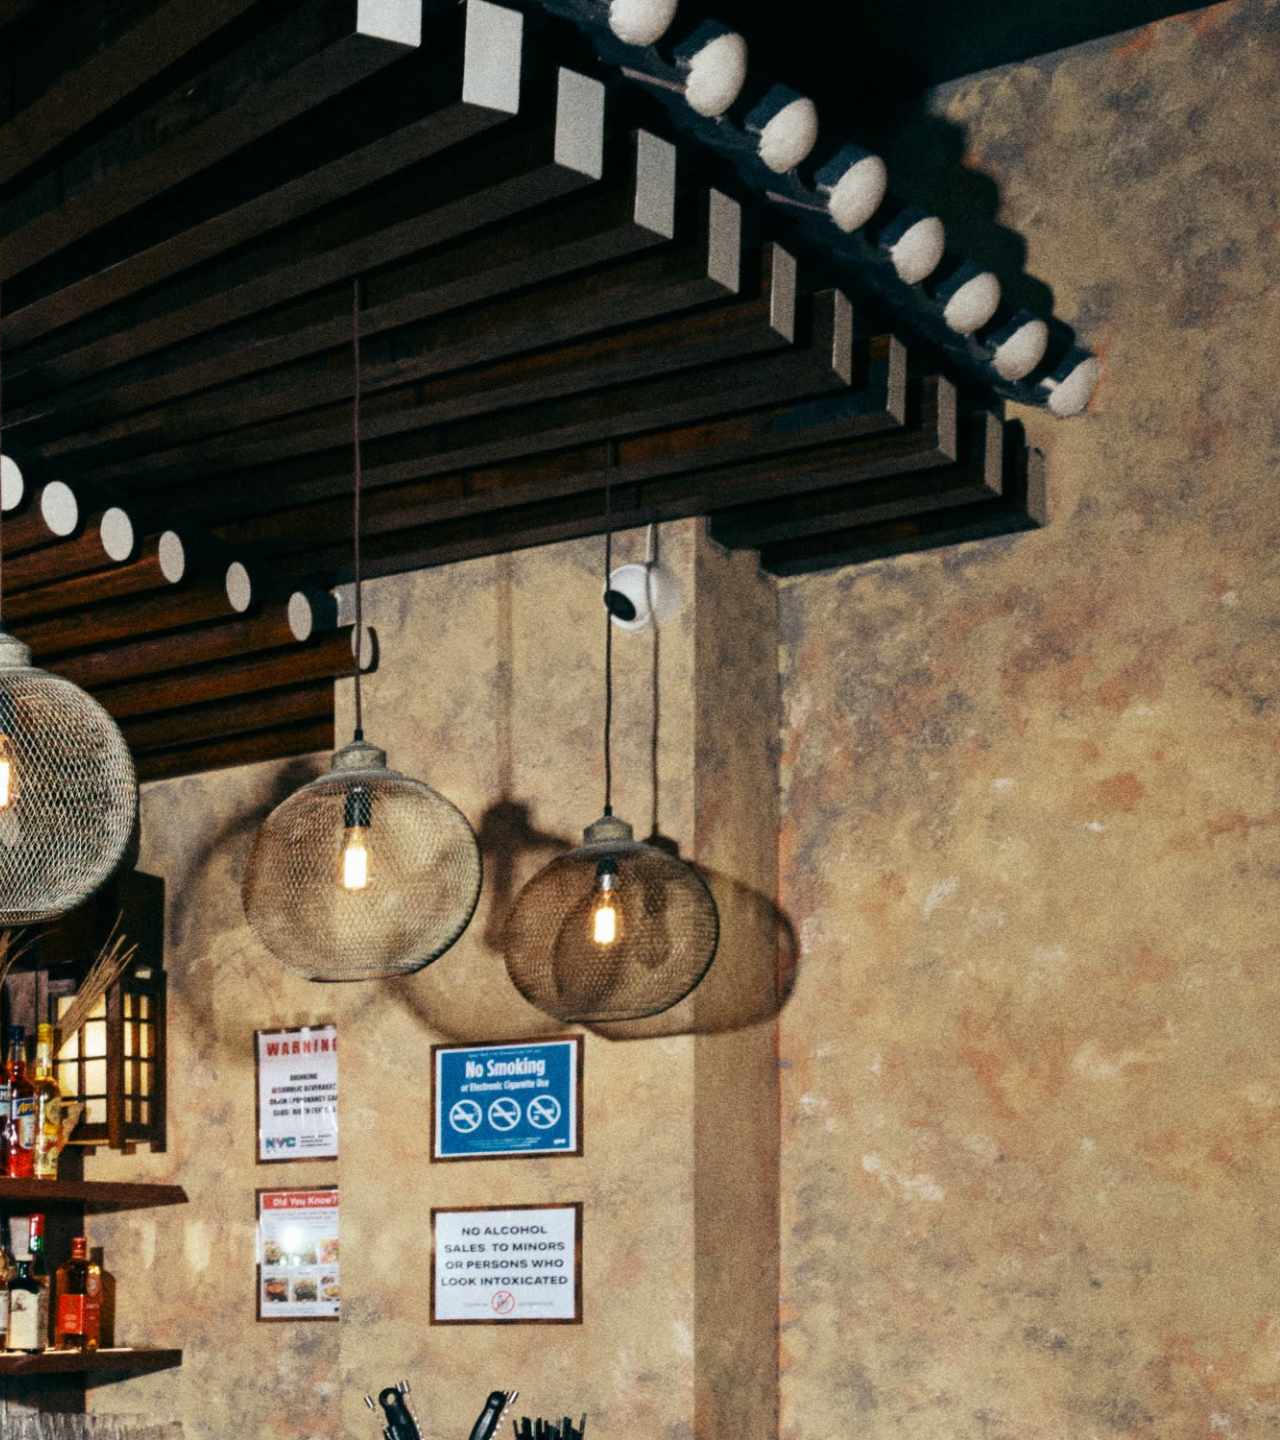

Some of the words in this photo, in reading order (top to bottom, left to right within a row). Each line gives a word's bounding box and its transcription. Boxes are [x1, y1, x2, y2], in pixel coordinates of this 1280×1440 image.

[465, 1060, 483, 1078] No
[487, 1057, 545, 1077] Smoking
[469, 1082, 502, 1092] Electronic
[504, 1080, 534, 1091] Cigarette
[265, 1137, 297, 1149] NYC
[461, 1226, 481, 1236] NO
[484, 1225, 548, 1236] ALCOHOL
[444, 1243, 486, 1253] SALES
[492, 1243, 509, 1252] TO
[512, 1241, 566, 1252] MINORS
[445, 1260, 464, 1270] OR
[466, 1259, 528, 1269] PERSONS
[531, 1258, 565, 1268] WHO
[441, 1277, 477, 1287] LOOK
[480, 1276, 569, 1287] INTOXICATED
